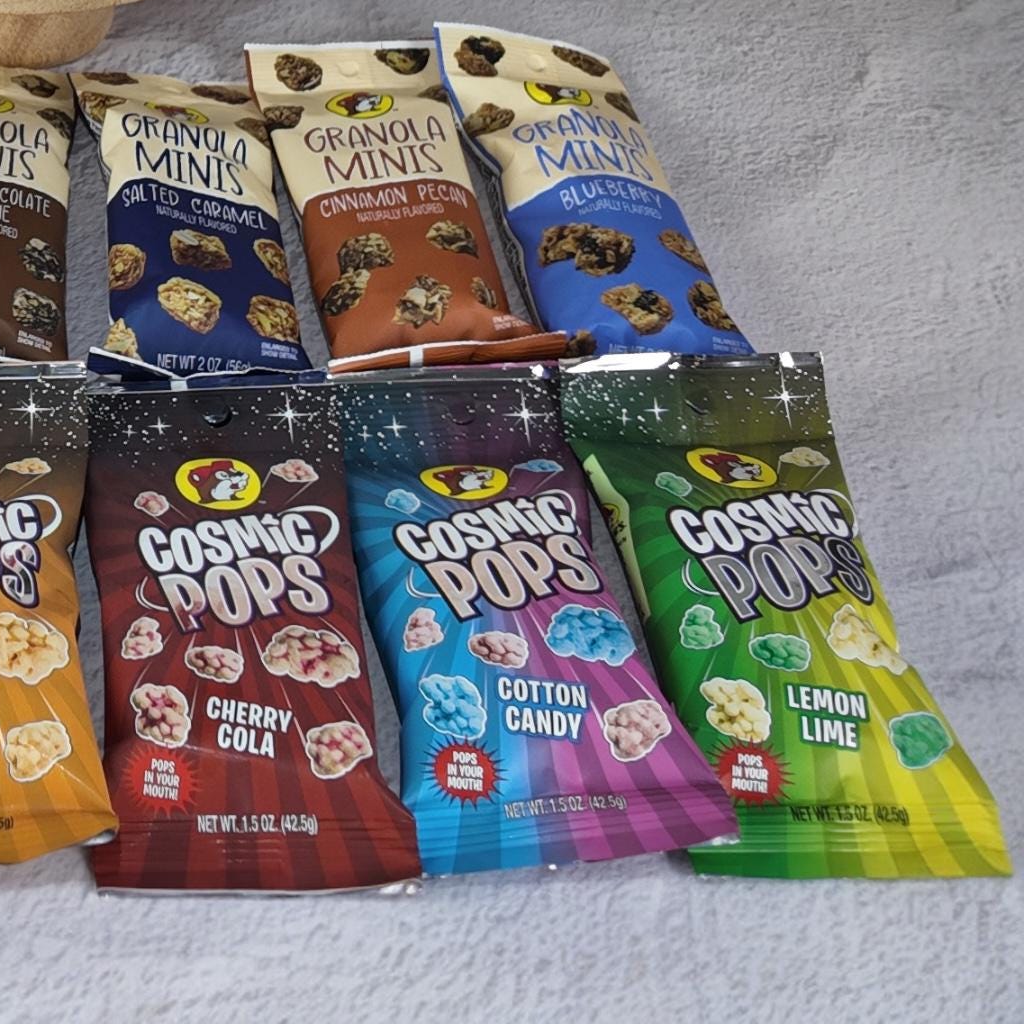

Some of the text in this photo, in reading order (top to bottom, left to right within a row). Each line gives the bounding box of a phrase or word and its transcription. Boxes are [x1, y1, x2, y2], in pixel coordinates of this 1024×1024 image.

[122, 113, 248, 170] GRANOLA
[304, 115, 446, 153] GRANOLA
[512, 108, 648, 155] GRANOLA
[136, 141, 243, 195] MINIS
[324, 143, 443, 184] MINIS
[535, 140, 653, 181] MINIS
[122, 184, 267, 230] SALTED CARAMEL
[320, 184, 468, 218] CINNAMON PECAN
[560, 179, 662, 211] BLUEBERRY
[156, 205, 237, 234] NATURALLY FLAVORED
[357, 203, 444, 223] NATURALLY FLAVORED
[158, 353, 177, 368] NET
[179, 355, 196, 369] WT
[198, 357, 205, 370] 2
[207, 357, 222, 372] OZ
[426, 535, 601, 621] POPS
[702, 537, 874, 623] POPS
[157, 555, 331, 634] POPS
[497, 676, 587, 708] COTTON
[786, 685, 867, 719] LEMON
[207, 696, 293, 734] CHERRY
[506, 706, 583, 739] CANDY
[217, 726, 275, 759] COLA
[802, 716, 858, 748] LIME
[151, 758, 175, 773] POPS
[447, 764, 483, 778] IN YOUR
[453, 751, 477, 764] POPS
[732, 765, 768, 780] IN YOUR
[738, 753, 762, 767] POPS
[143, 784, 178, 801] MOUTH!
[145, 770, 179, 788] IN YOUR
[447, 777, 483, 791] MOUTH!
[731, 778, 768, 793] MOUTH!
[504, 796, 627, 819] NET WT. 1.5 OZ. (42.5g)
[790, 807, 909, 824] NET WT. 1.5 OZ. (42.5g)
[197, 814, 318, 835] NET WT. 1.5 OZ. (42.5g)
